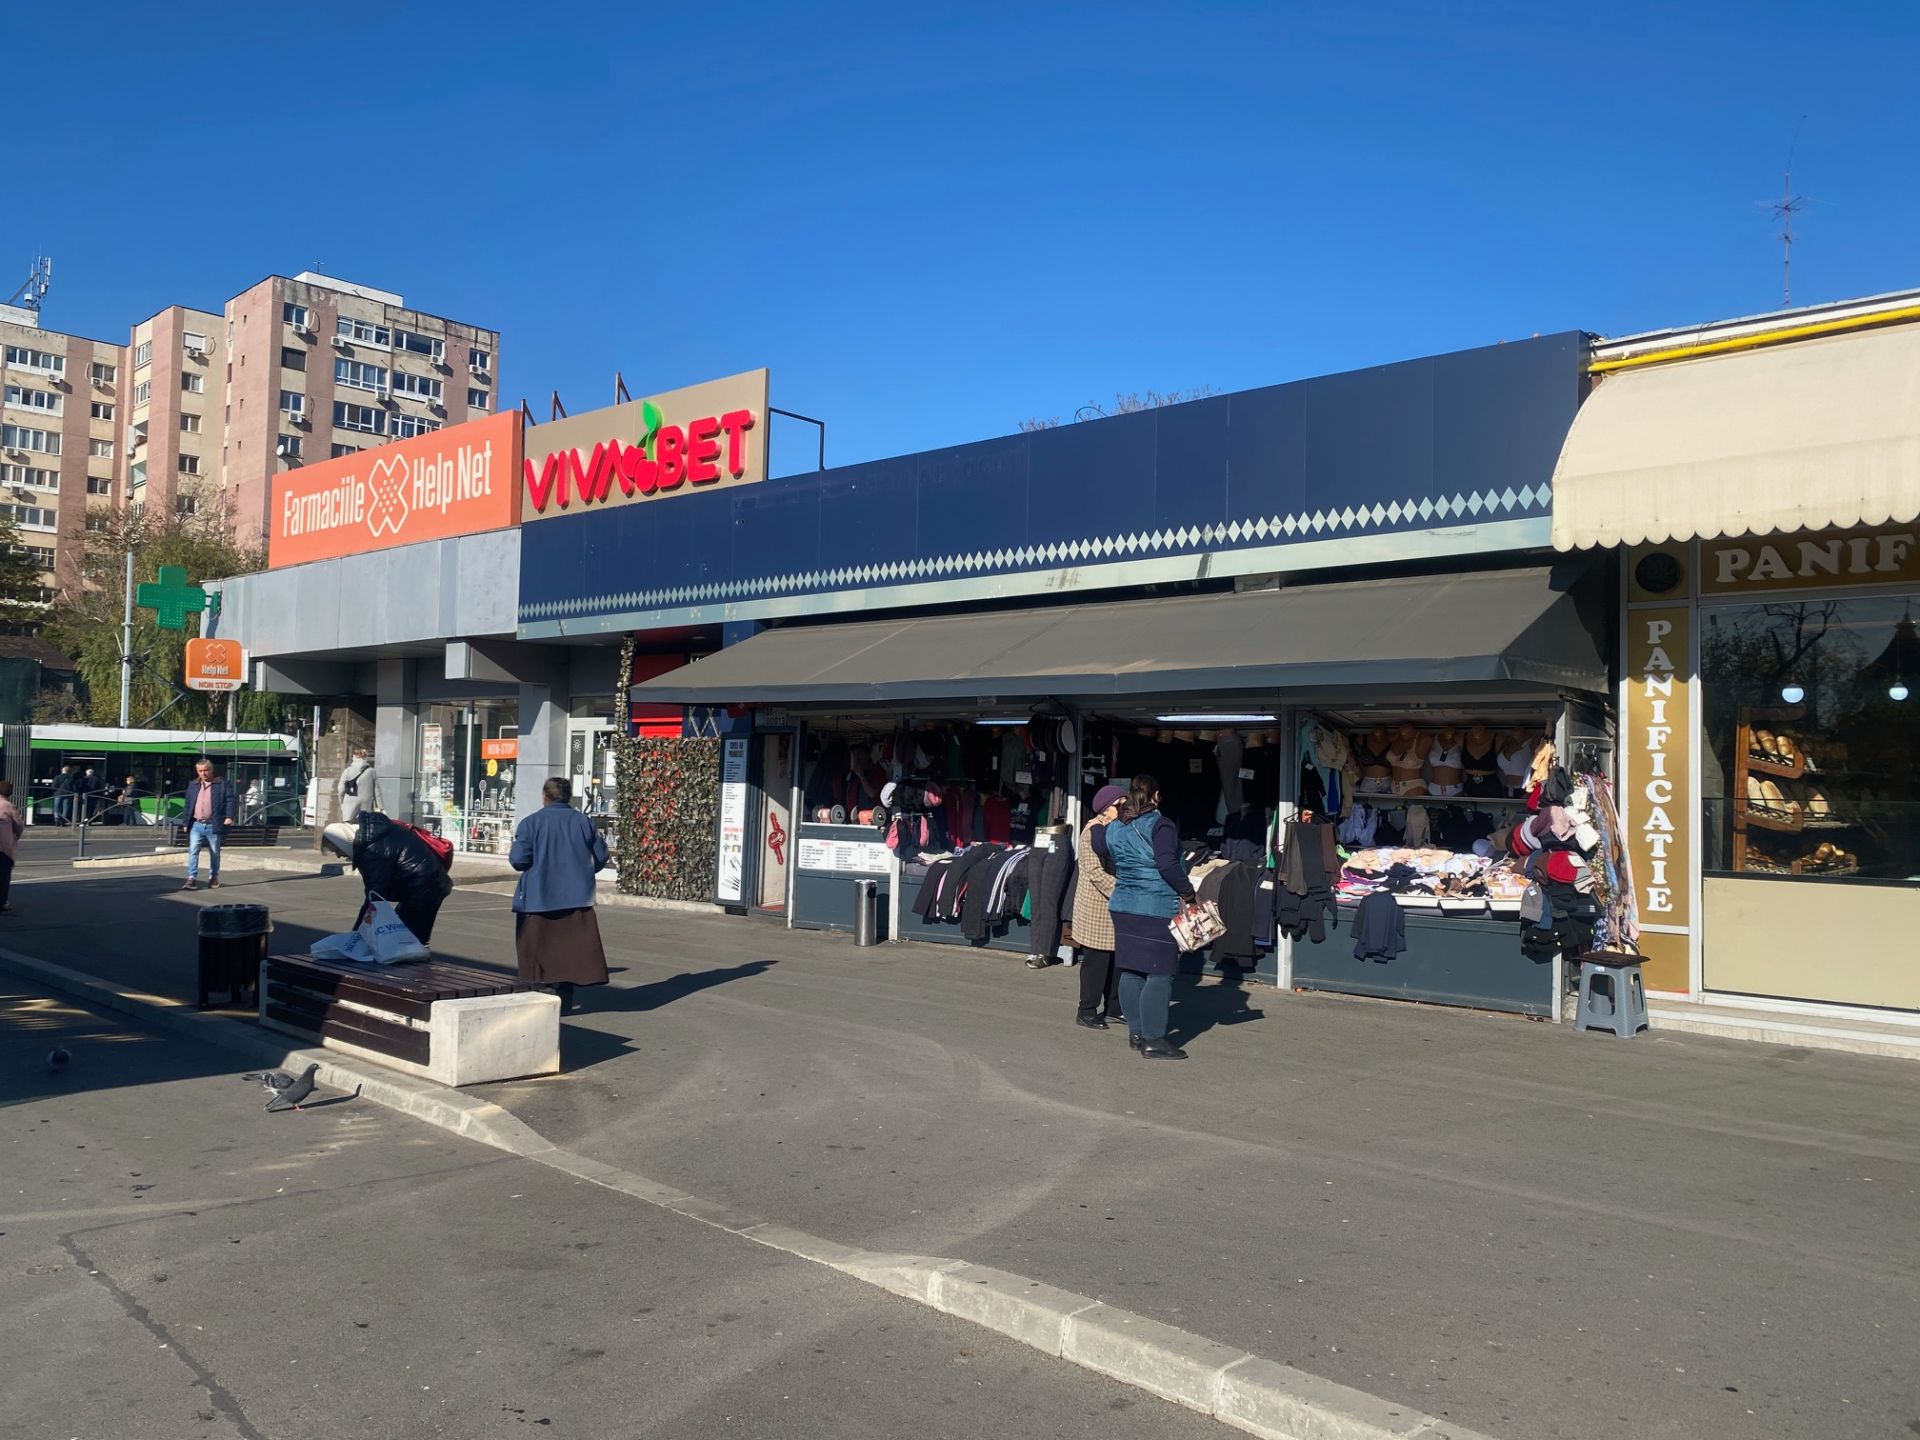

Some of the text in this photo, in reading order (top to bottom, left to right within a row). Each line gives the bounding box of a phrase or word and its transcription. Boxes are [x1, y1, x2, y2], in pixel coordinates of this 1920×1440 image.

[283, 440, 492, 538] Farmaciile Help Net
[1714, 532, 1914, 584] PANIF
[1642, 619, 1675, 913] PANIFICATIE
